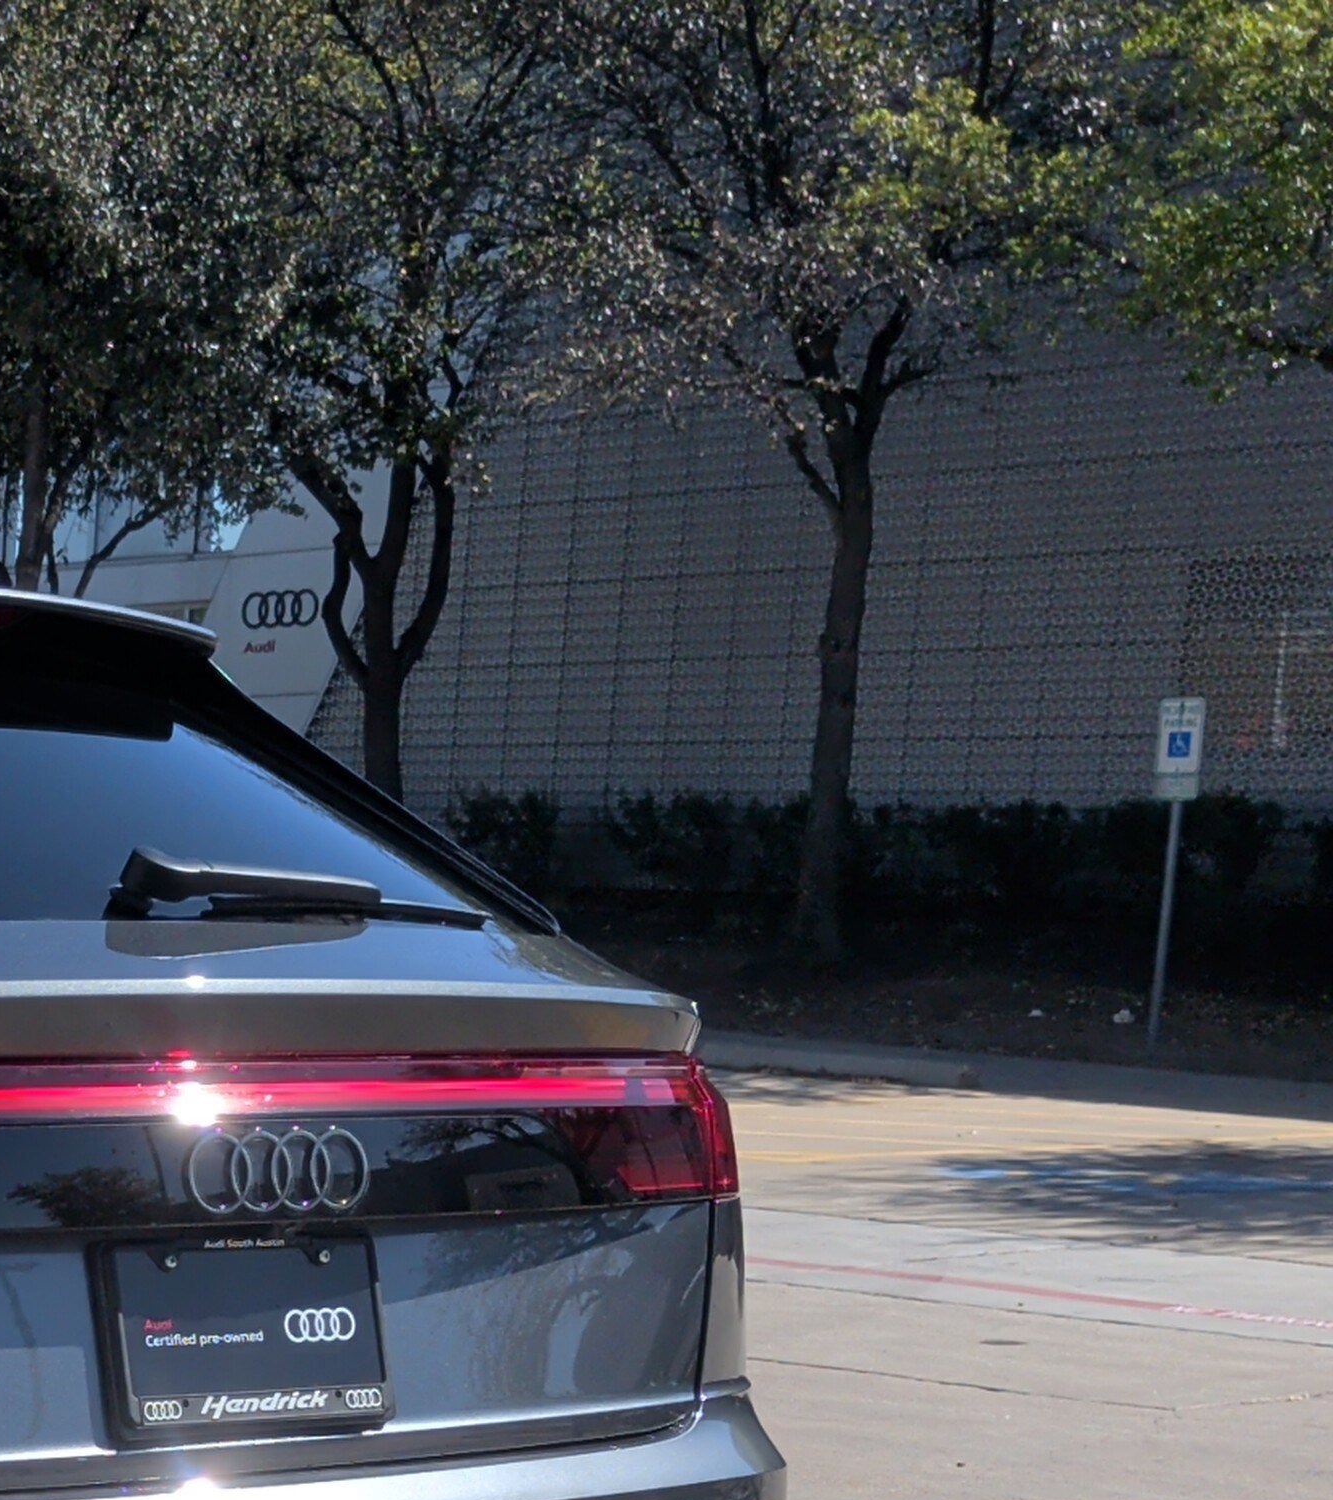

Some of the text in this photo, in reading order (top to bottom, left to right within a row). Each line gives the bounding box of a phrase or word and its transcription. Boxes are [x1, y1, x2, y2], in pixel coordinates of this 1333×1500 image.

[243, 639, 276, 653] Audi
[144, 1319, 174, 1331] Audi
[145, 1330, 264, 1347] Certified pre-owned
[200, 1390, 329, 1420] Hendrick
